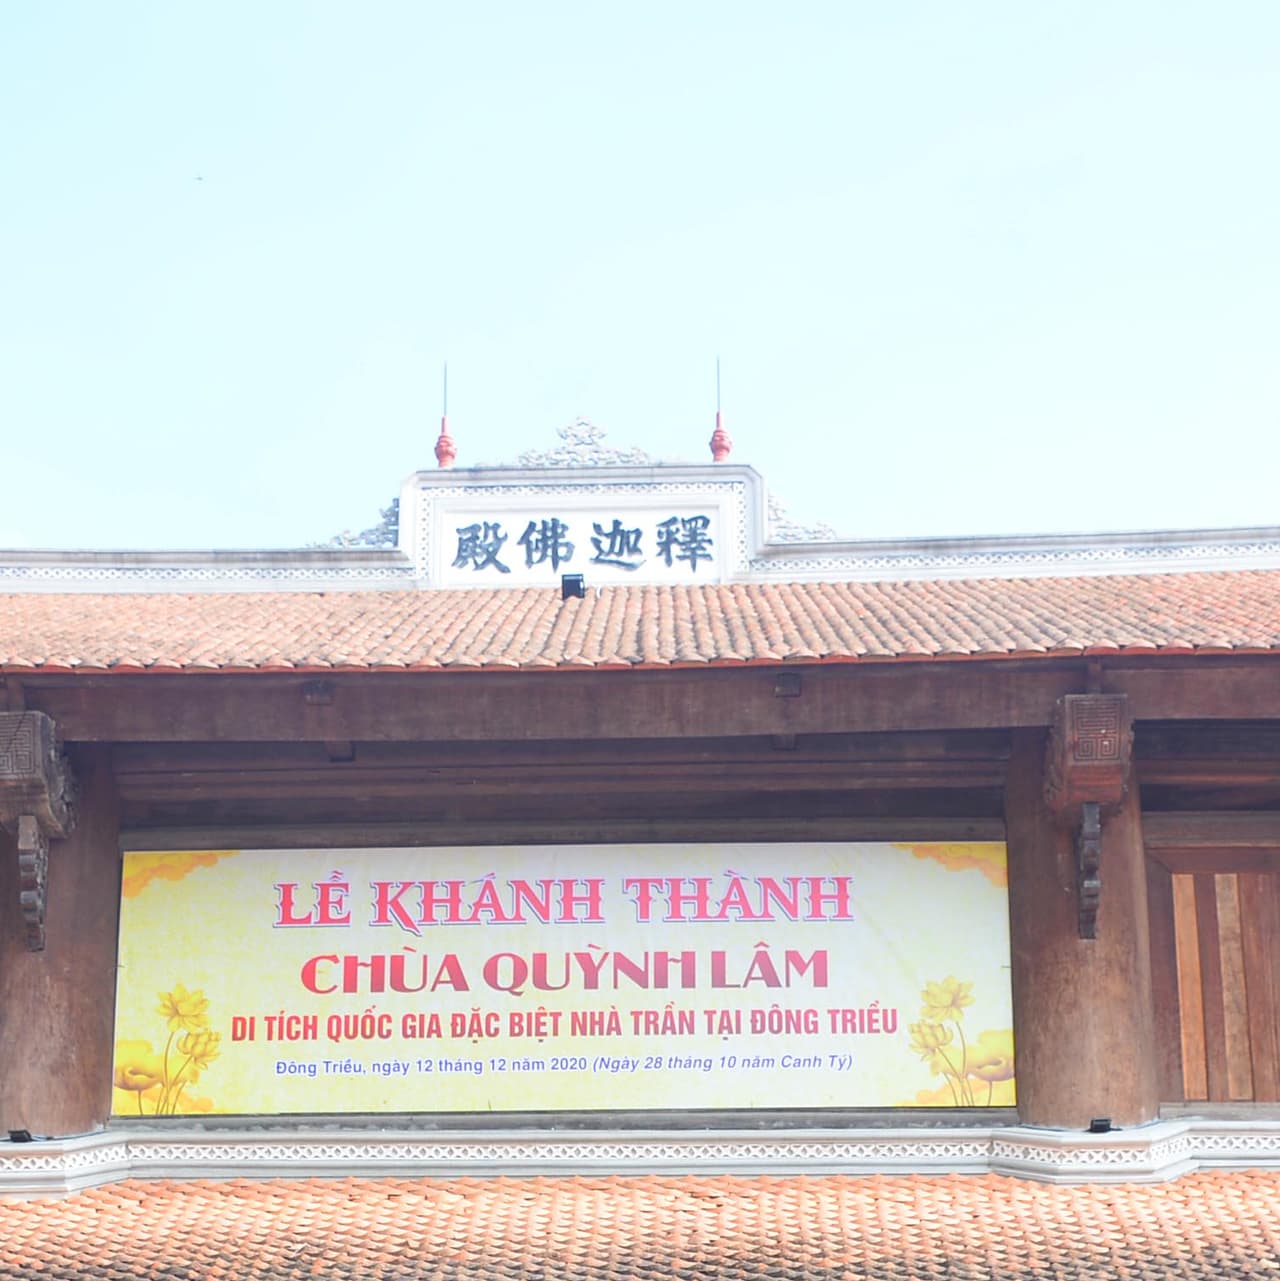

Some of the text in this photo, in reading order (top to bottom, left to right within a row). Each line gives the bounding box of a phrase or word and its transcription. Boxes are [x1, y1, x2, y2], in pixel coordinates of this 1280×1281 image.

[273, 869, 854, 937] LỄ KHÁNH THÀNH
[300, 941, 829, 997] CHÙA QUỲNH LÂM
[231, 1000, 898, 1043] DI TÍCH QUỐC GIA ĐẶC BIỆT NHÀ TRẦN TẠI ĐÔNG TRIỀU
[276, 1061, 317, 1077] Đông
[372, 1059, 410, 1076] ngày
[416, 1059, 433, 1072] 12
[438, 1058, 483, 1075] tháng
[489, 1058, 506, 1071] 12
[512, 1057, 545, 1071] năm
[550, 1056, 587, 1070] 2020
[593, 1055, 640, 1073] (Ngày
[644, 1056, 663, 1069] 28
[668, 1055, 713, 1072] tháng
[720, 1055, 737, 1068] 10
[741, 1055, 775, 1068] năm
[781, 1054, 822, 1068] Canh
[828, 1053, 853, 1071] Tý)
